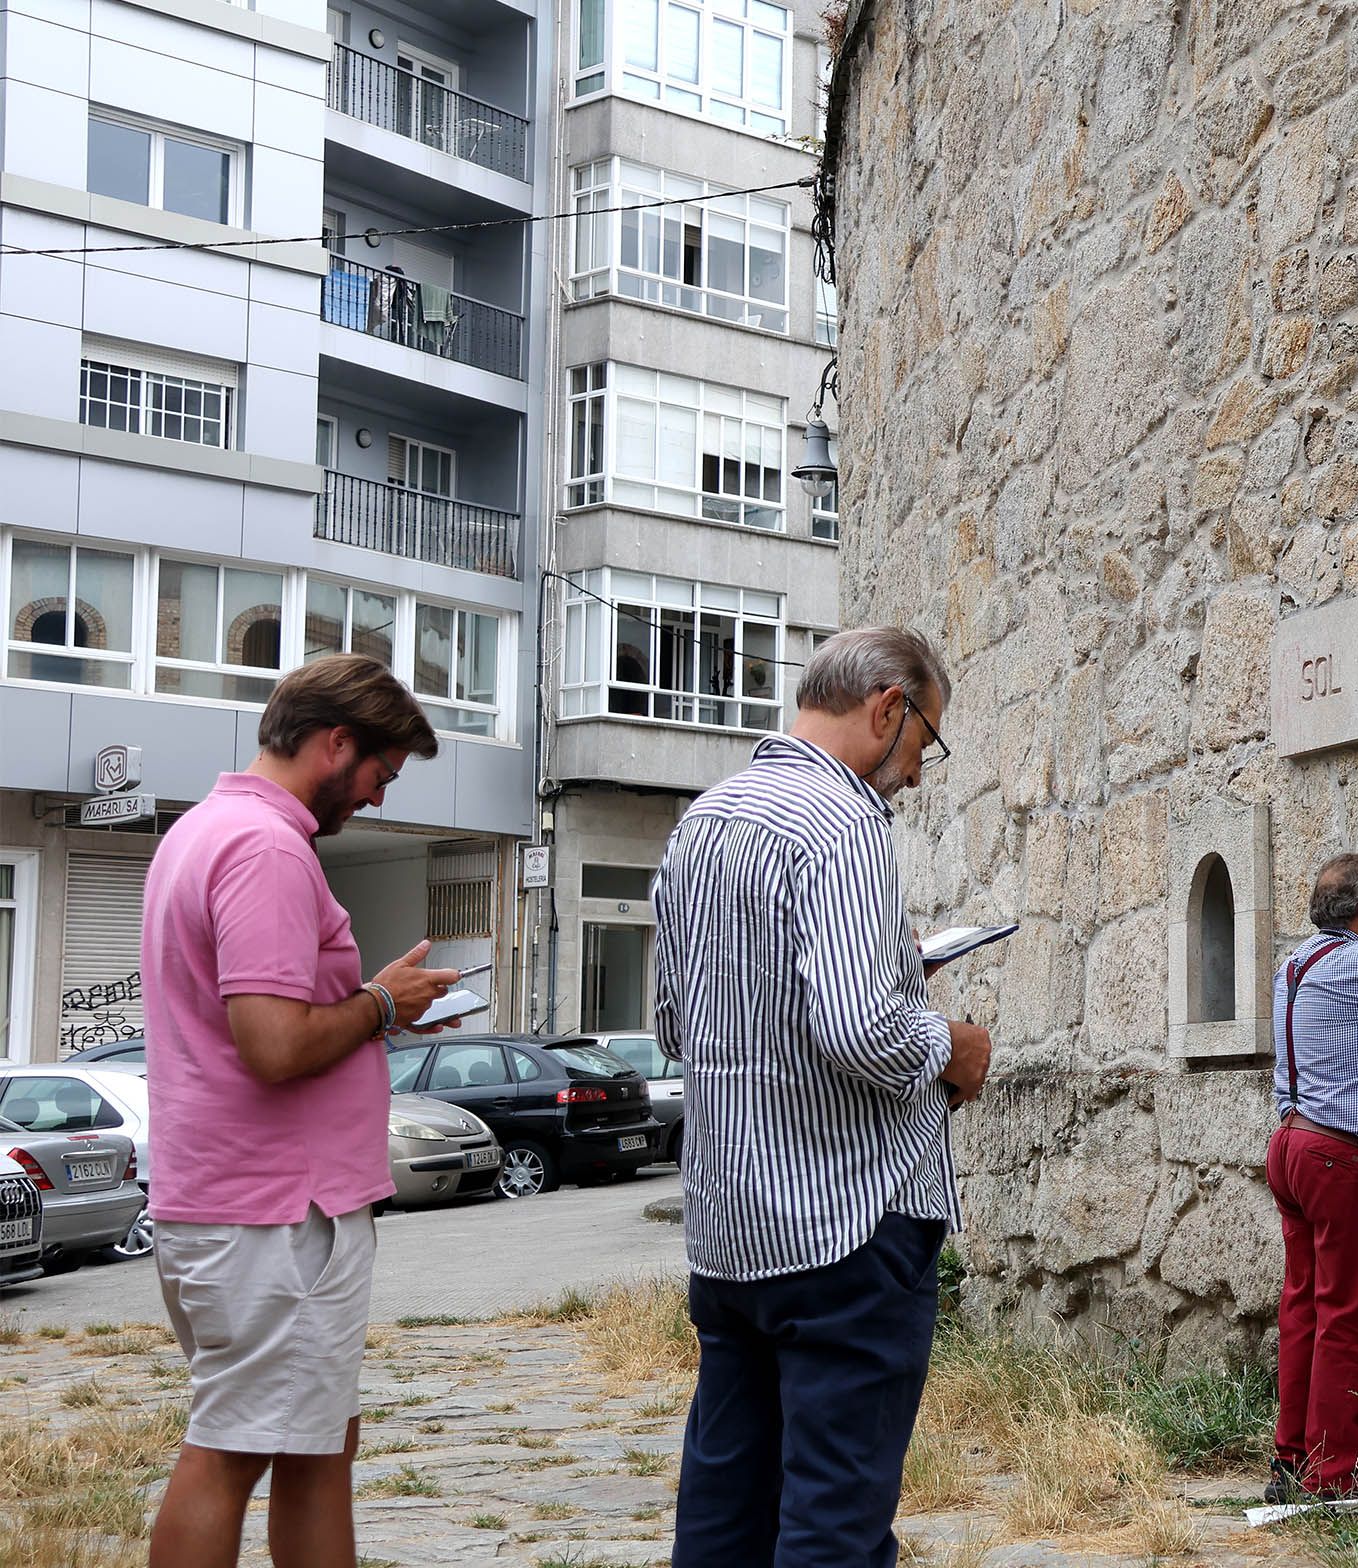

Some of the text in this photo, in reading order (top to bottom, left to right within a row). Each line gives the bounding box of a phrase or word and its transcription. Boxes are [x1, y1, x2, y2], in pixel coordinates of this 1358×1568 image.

[1302, 654, 1342, 701] SOL
[84, 800, 138, 818] MAFARI SA
[72, 1164, 94, 1178] 2162
